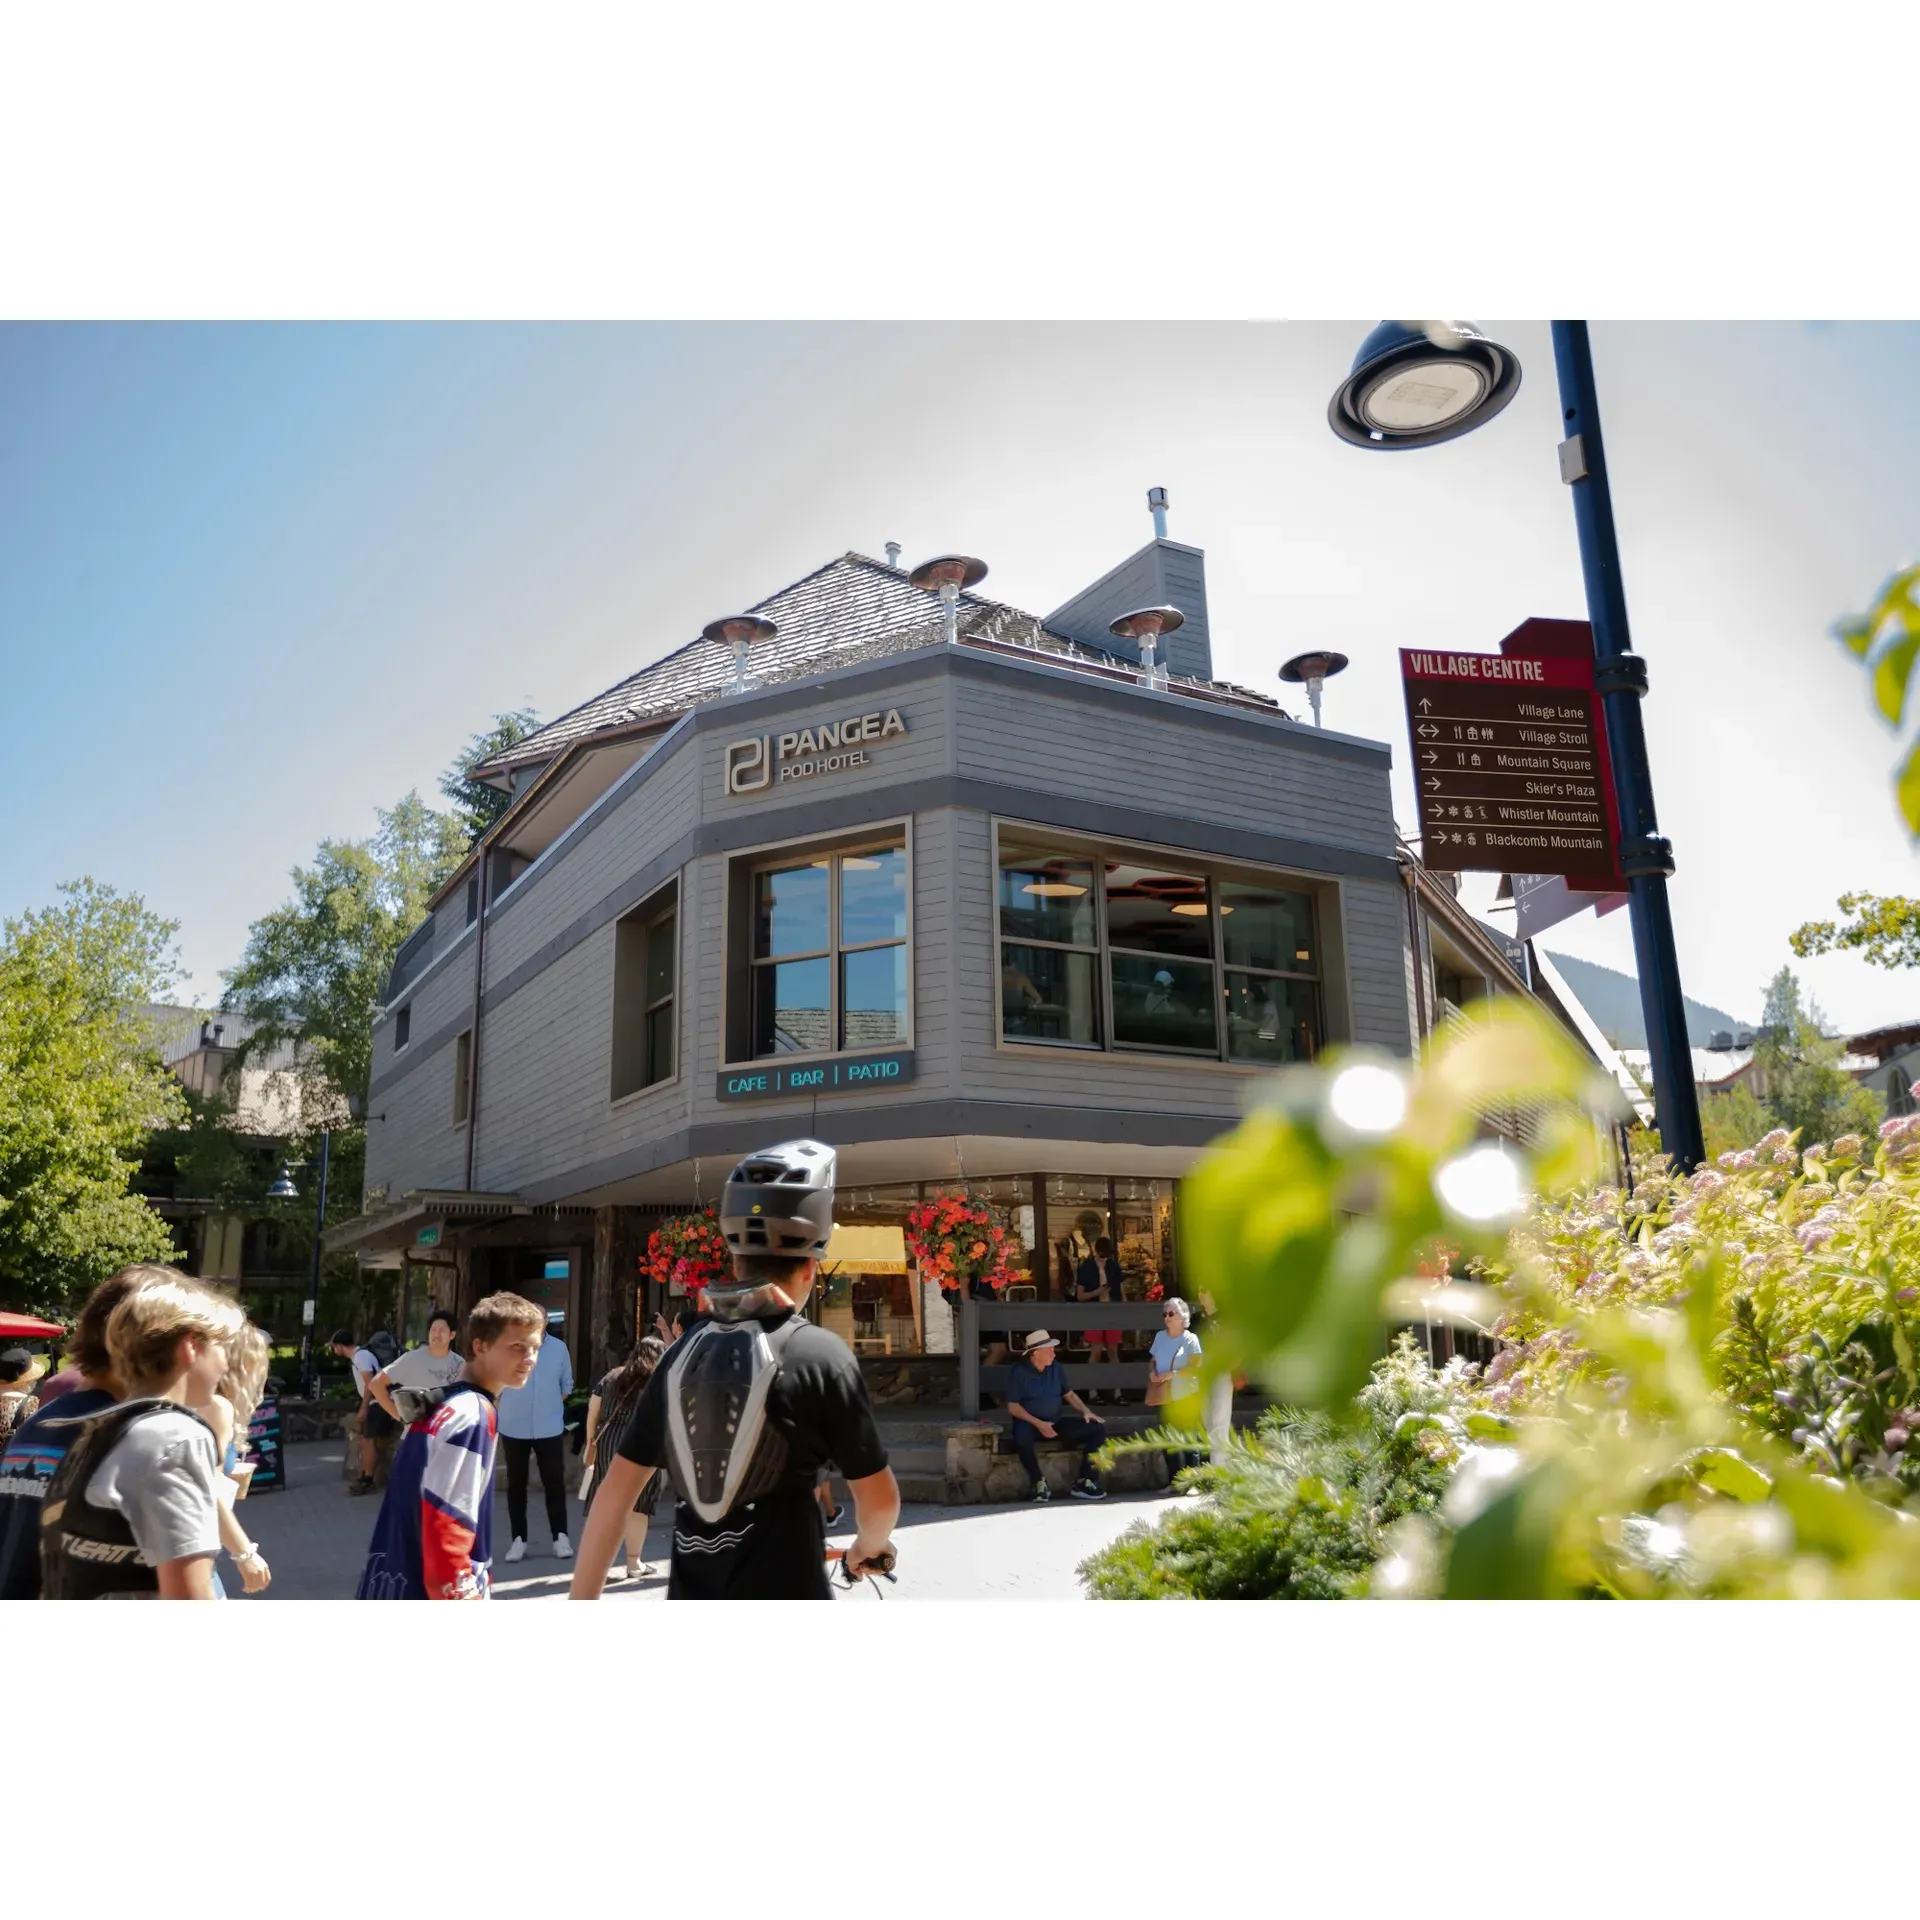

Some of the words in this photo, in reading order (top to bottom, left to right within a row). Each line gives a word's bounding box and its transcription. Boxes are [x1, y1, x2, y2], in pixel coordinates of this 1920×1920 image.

[1410, 653, 1479, 677] VILLAGE
[1481, 658, 1544, 681] CENTRE
[1518, 704, 1555, 720] Village
[1558, 706, 1584, 719] Lane
[778, 708, 905, 760] PANGEA
[1519, 730, 1556, 746] Village
[1559, 732, 1588, 744] Stroll
[780, 763, 814, 781] POD
[816, 750, 870, 774] HOTEL
[1497, 754, 1549, 768] Mountain
[1552, 757, 1591, 772] Square
[1526, 782, 1564, 795] Skier's
[1566, 784, 1595, 796] Plaza
[1499, 807, 1544, 820] Whistler
[1547, 809, 1599, 822] Mountain
[1486, 833, 1548, 847] Blackcomb
[1550, 836, 1602, 850] Mountain
[728, 1076, 767, 1093] CAFE
[790, 1069, 824, 1087] BAR
[848, 1061, 899, 1081] PATIO
